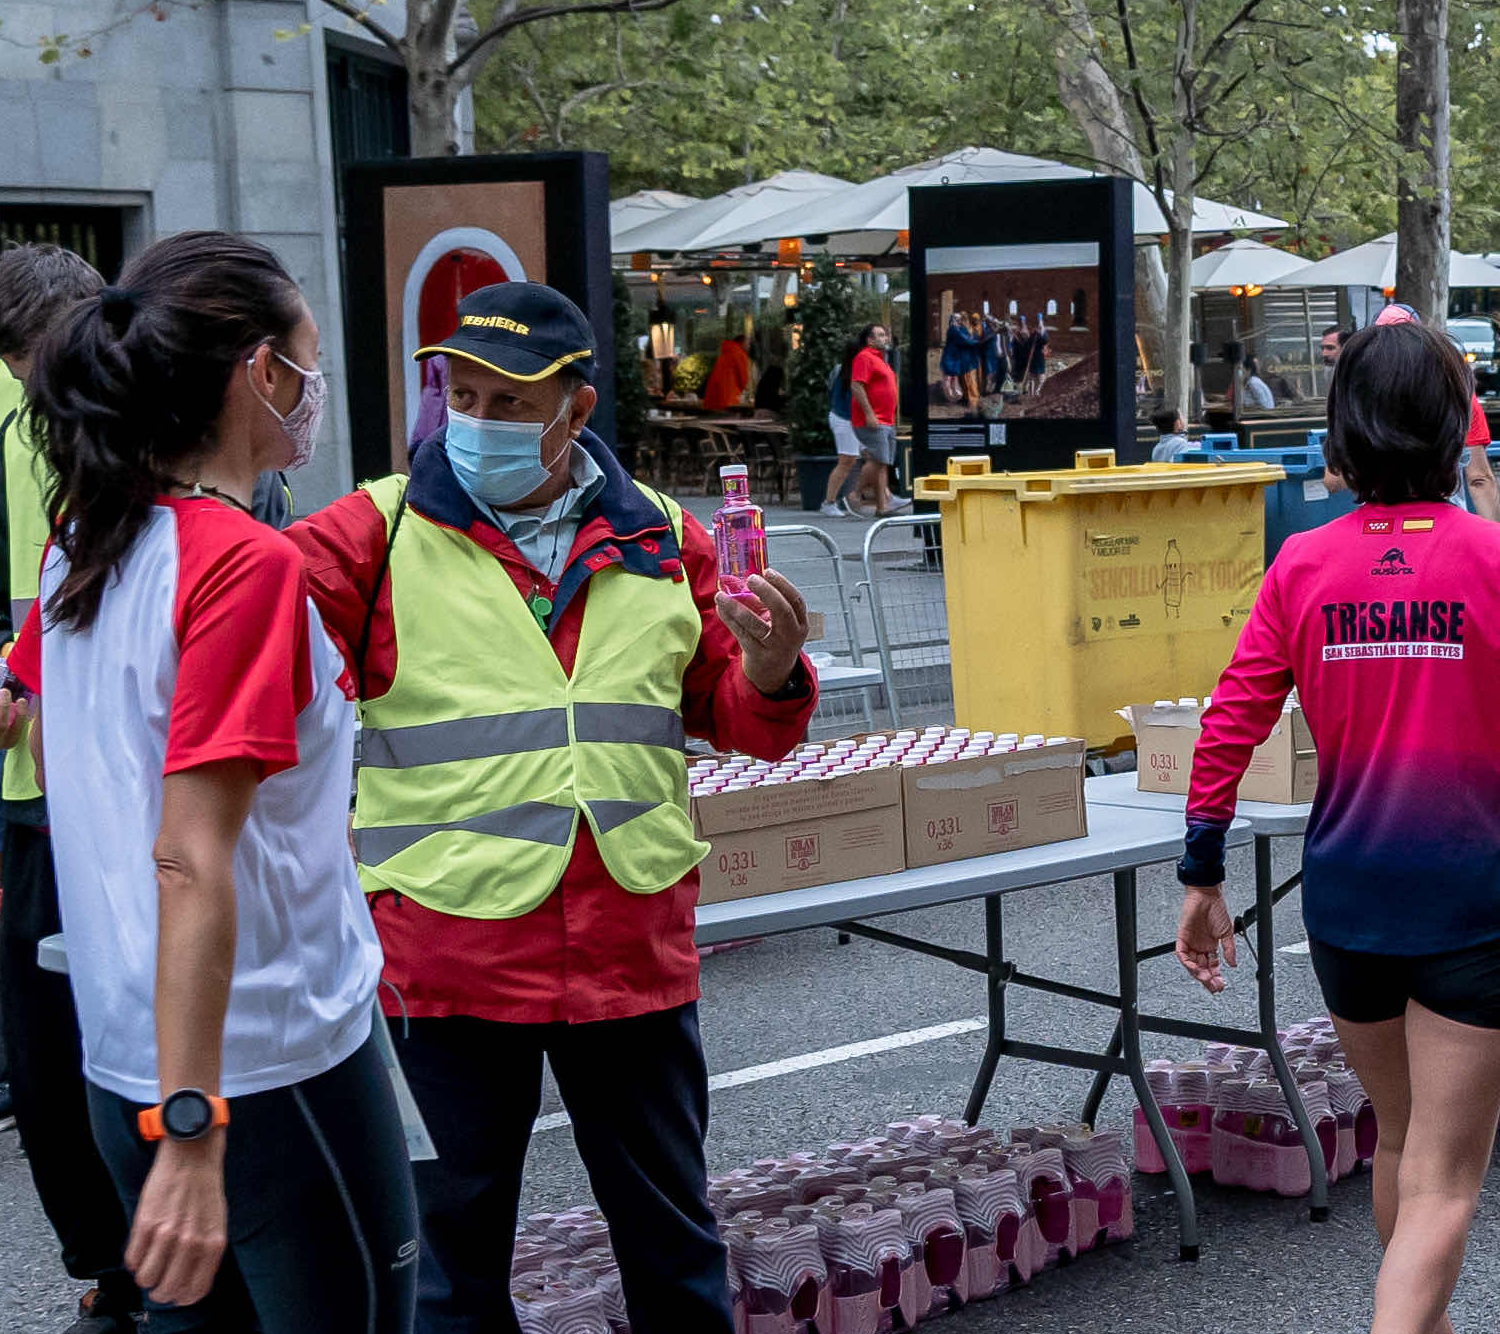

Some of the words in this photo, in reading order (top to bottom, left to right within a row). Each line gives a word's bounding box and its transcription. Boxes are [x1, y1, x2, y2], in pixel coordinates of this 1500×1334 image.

[461, 315, 530, 335] IEBHERR
[1325, 646, 1343, 659] SAN
[1345, 643, 1396, 657] SEBASTIÁN
[1399, 645, 1410, 656] DE
[1412, 645, 1429, 656] LOS
[1431, 645, 1460, 657] REYES
